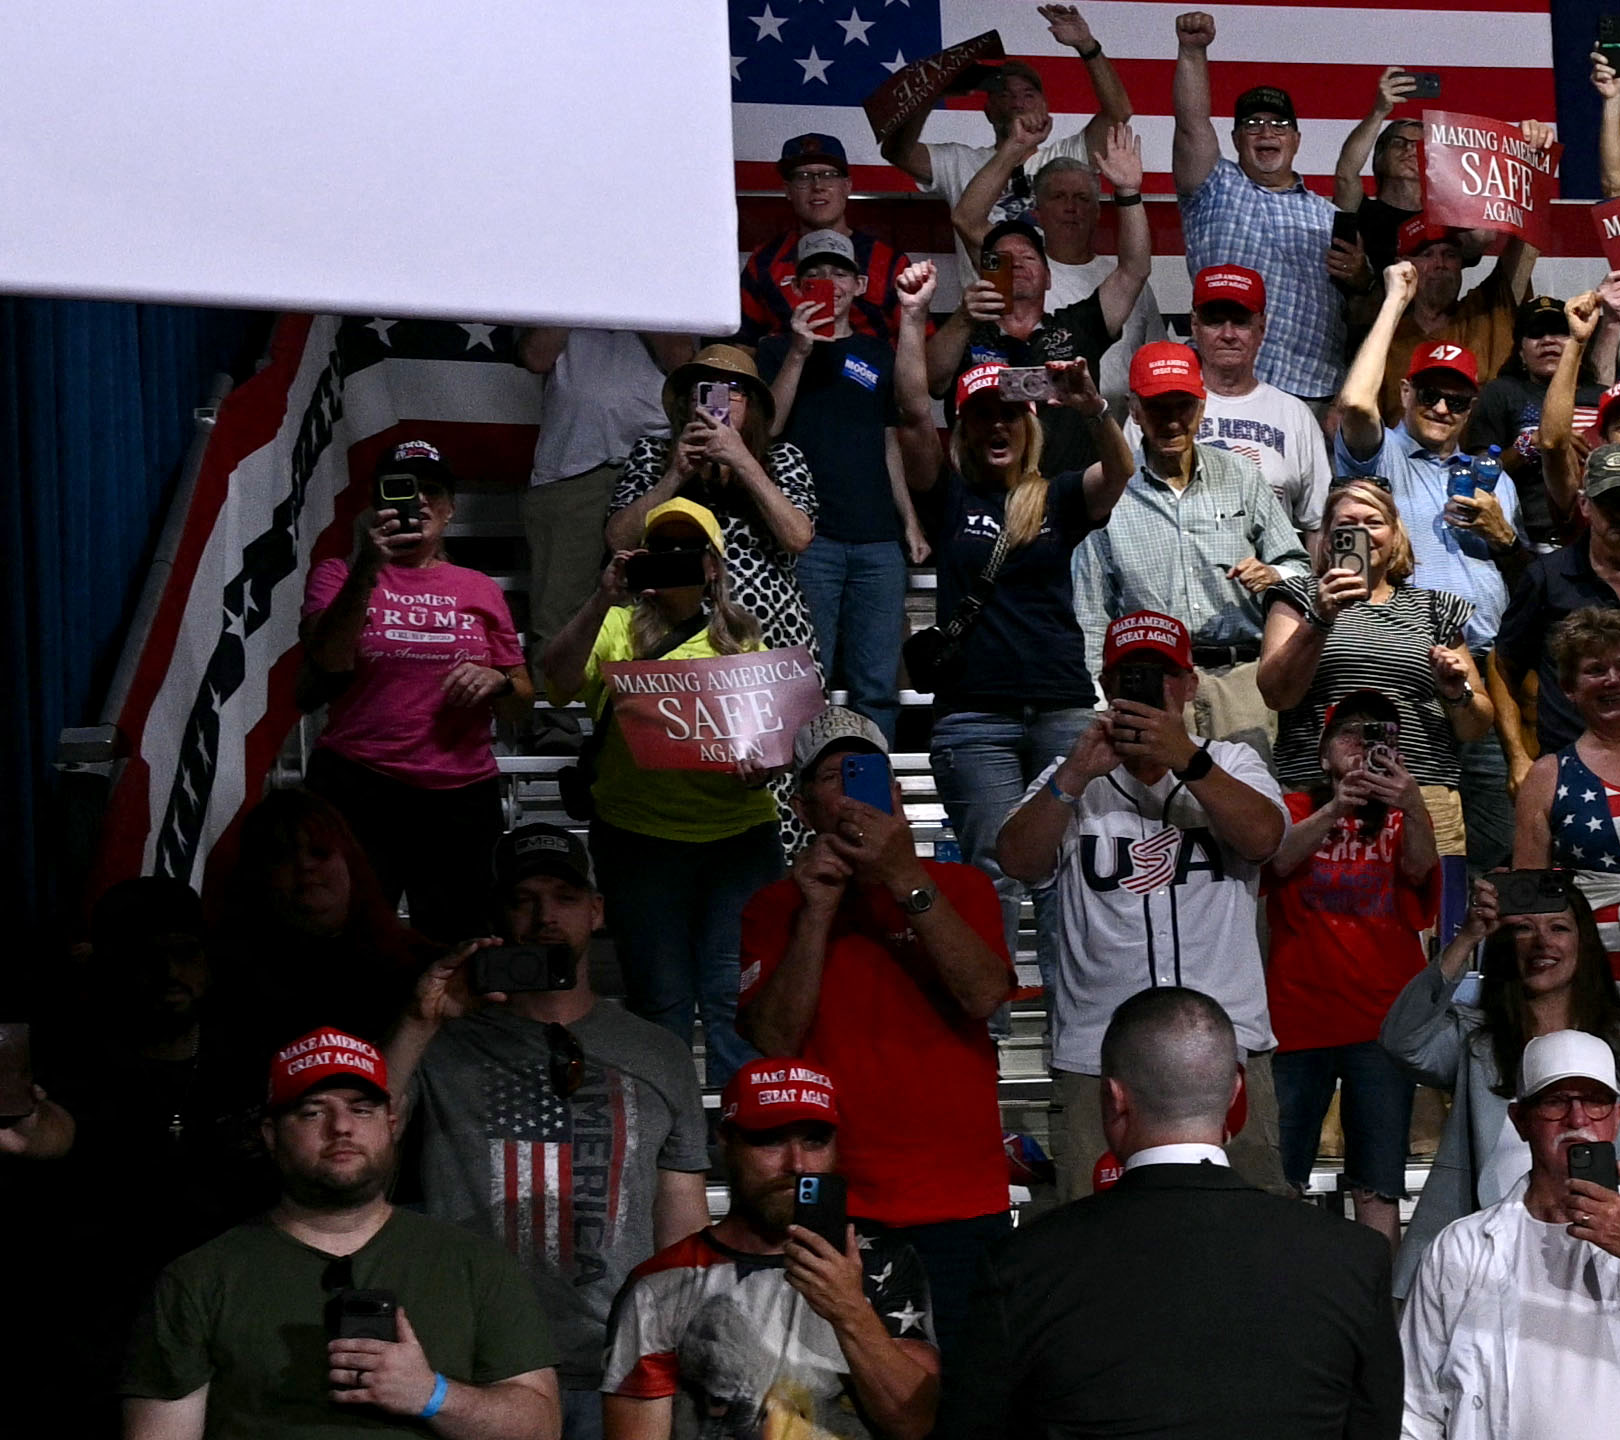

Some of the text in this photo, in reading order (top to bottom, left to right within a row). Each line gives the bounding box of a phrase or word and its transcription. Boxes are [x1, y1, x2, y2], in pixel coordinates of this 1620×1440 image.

[1431, 123, 1498, 152] MAKING
[1461, 151, 1534, 212] SAFE
[1483, 202, 1524, 229] AGAIN
[1428, 345, 1463, 361] 47
[1218, 418, 1285, 458] NATION
[383, 588, 457, 609] WOMEN
[1112, 615, 1181, 636] MAKE AMERICA
[1114, 629, 1178, 648] GREAT AGAIN
[613, 660, 808, 698] MAKING AMERICA
[657, 690, 784, 742] SAFE
[1080, 824, 1227, 894] USA
[279, 1032, 382, 1064] MAKE AMERICA
[287, 1051, 376, 1077] GREAT AGAIN
[750, 1067, 836, 1090] MAKE AMERICA
[758, 1089, 832, 1108] GREAT AGAIN
